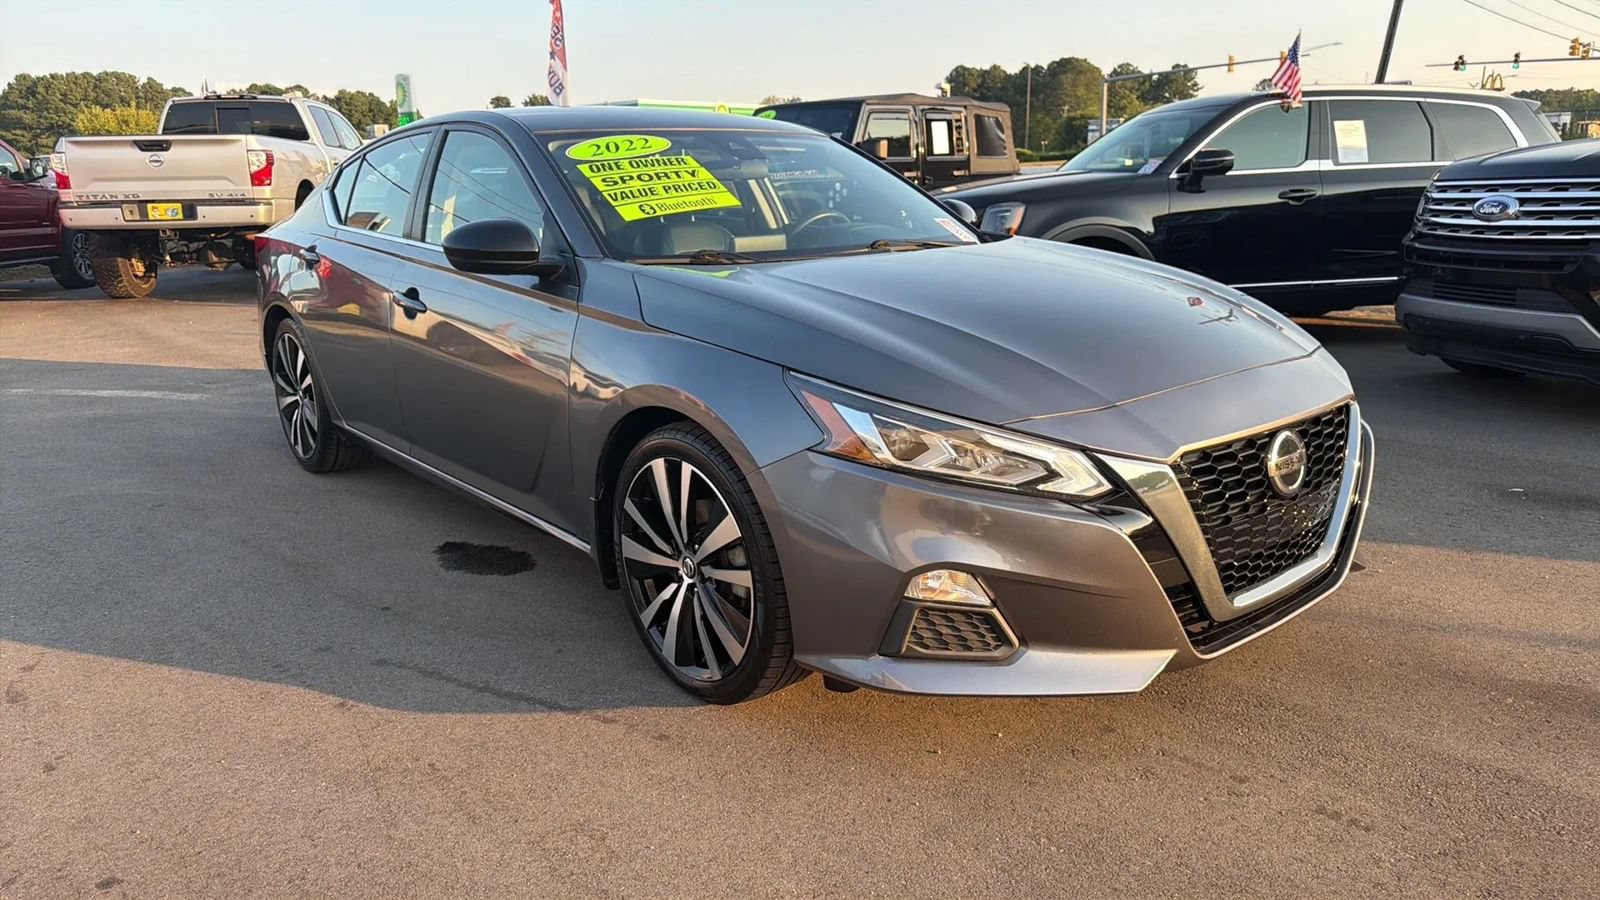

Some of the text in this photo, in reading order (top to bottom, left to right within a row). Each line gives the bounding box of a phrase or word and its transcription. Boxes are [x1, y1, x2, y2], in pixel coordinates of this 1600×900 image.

[589, 138, 652, 157] 2022
[589, 157, 687, 173] ONE OWNER
[601, 169, 699, 187] SPORTY
[608, 181, 717, 202] VALUE PRICED
[656, 195, 717, 212] Bluetooth
[1480, 202, 1502, 214] Ford
